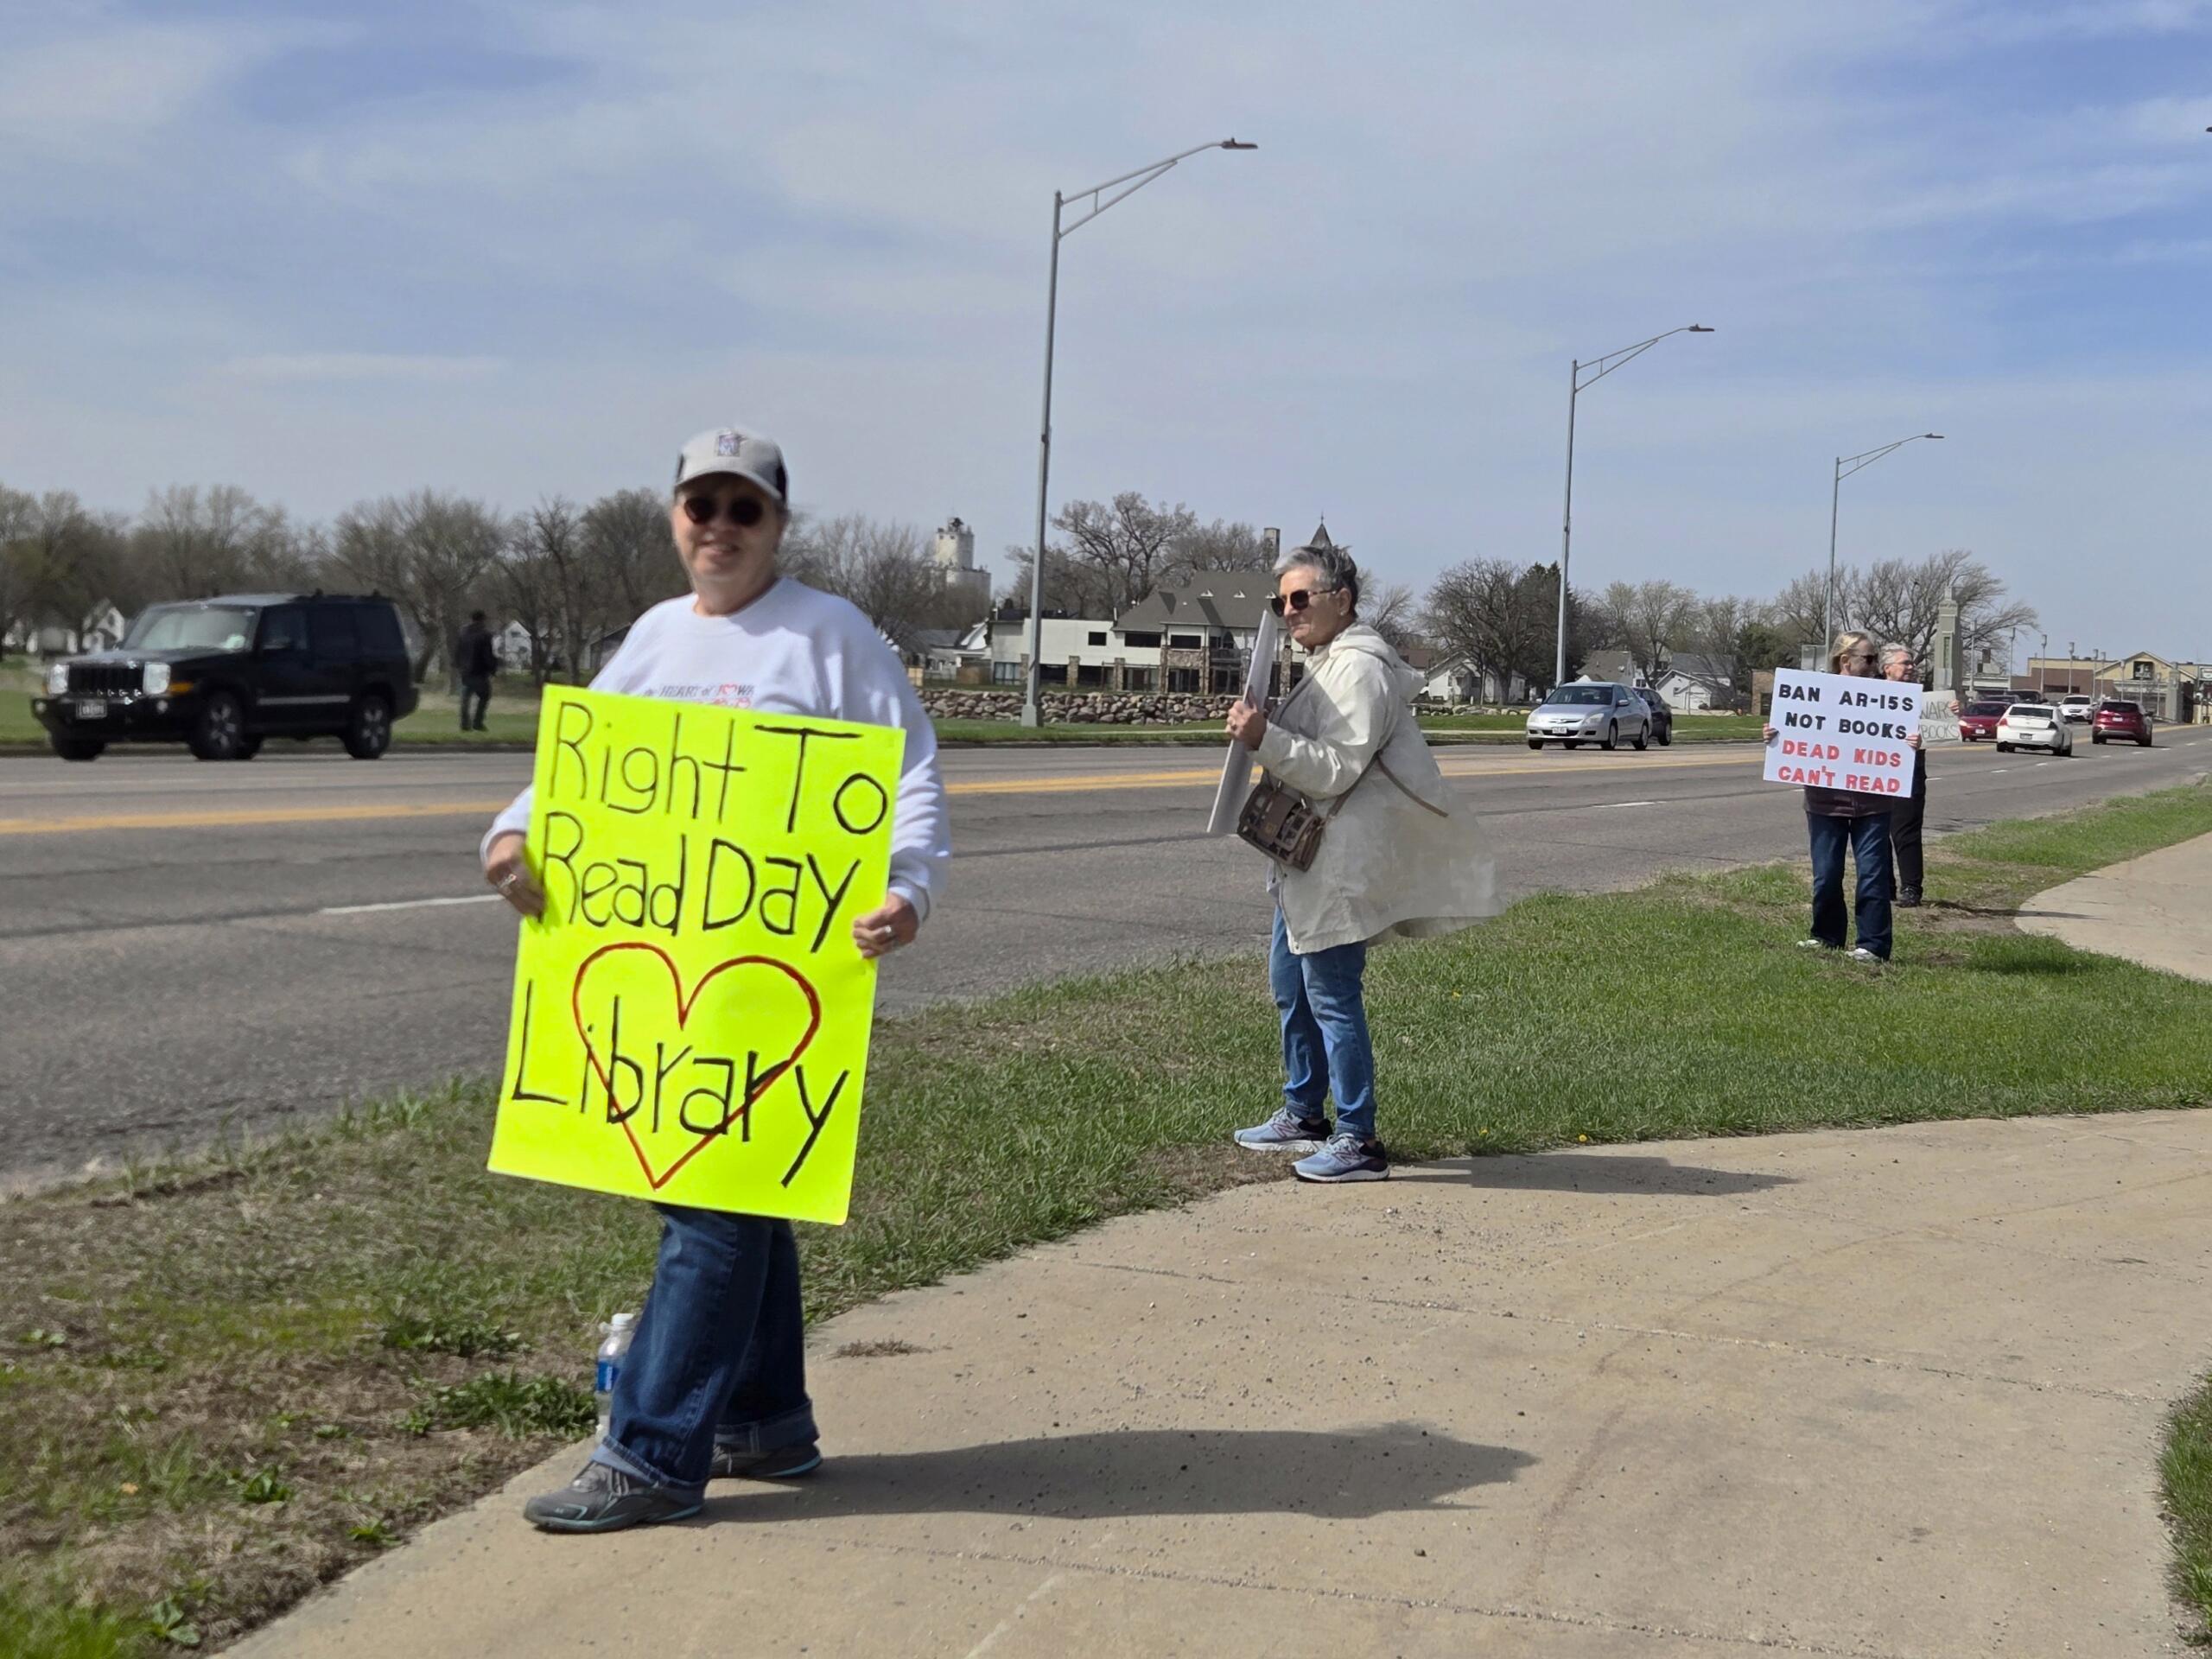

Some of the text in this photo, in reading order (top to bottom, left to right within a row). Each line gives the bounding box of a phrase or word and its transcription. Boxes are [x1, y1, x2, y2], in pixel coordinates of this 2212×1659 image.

[1778, 683, 1821, 702] BAN
[1785, 712, 1907, 741] NOT BOOKS
[1921, 724, 1961, 740] BOOKS
[1782, 740, 1902, 767] DEAD KIDS
[550, 701, 888, 835] Right To
[1777, 766, 1901, 793] CAN'T READ
[543, 811, 861, 953] Read Day
[511, 978, 849, 1188] Library
